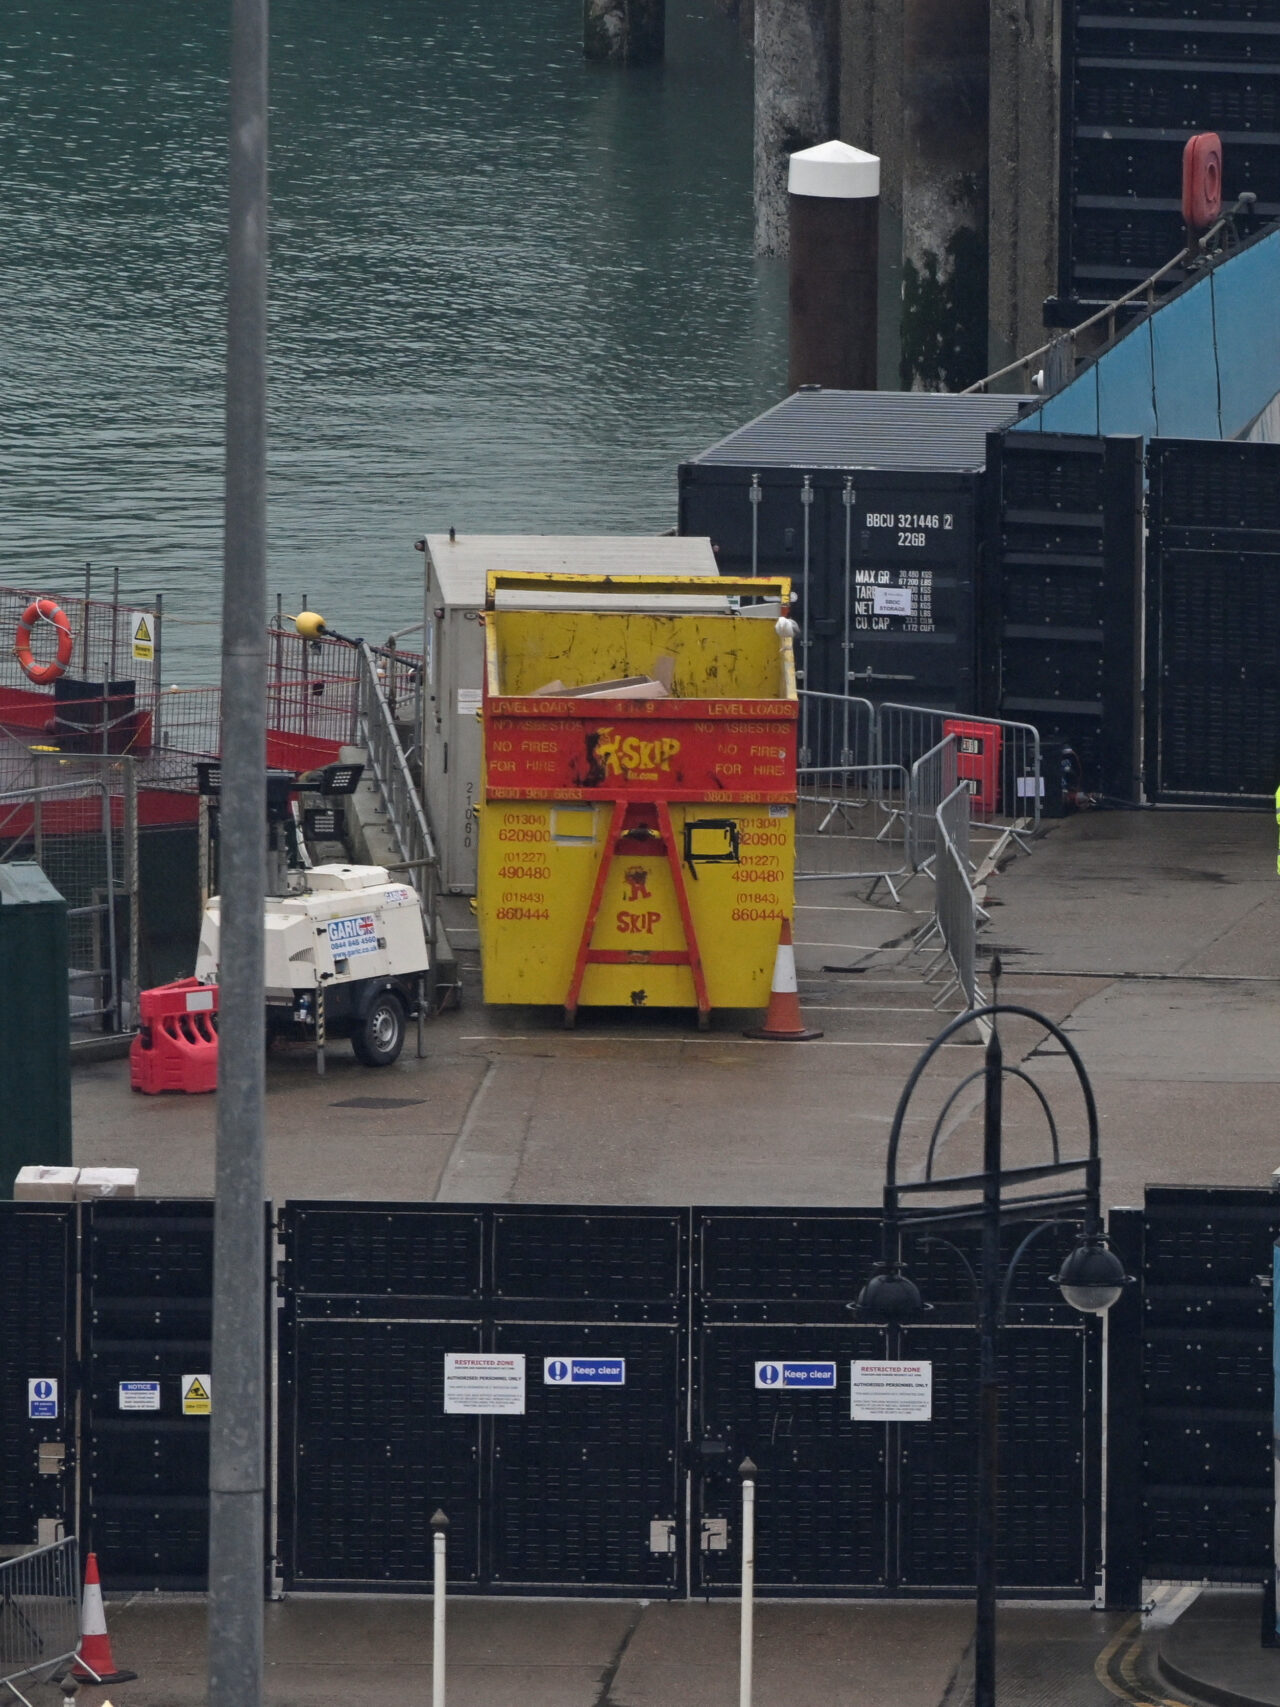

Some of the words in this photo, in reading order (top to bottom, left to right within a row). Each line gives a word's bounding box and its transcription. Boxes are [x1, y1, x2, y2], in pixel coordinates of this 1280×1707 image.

[866, 513, 895, 528] BBCU
[898, 514, 939, 529] 321446
[945, 515, 953, 529] 2
[855, 601, 873, 615] NET
[533, 702, 576, 713] LOADS
[708, 704, 746, 716] LEVEL
[750, 704, 792, 716] LOADS
[695, 722, 714, 733] NO
[493, 741, 512, 752] NO
[521, 741, 558, 753] FIRES
[718, 743, 738, 755] NO
[490, 760, 516, 772] FOR
[526, 760, 556, 772] HIRE
[715, 763, 742, 775] FOR
[753, 764, 784, 776] HIRE
[503, 813, 547, 826] (01304)
[498, 829, 551, 842] 620900
[504, 852, 547, 863] (01227)
[498, 866, 551, 879] 490480
[732, 869, 784, 882] 490480
[502, 892, 545, 903] (01843)
[737, 893, 779, 904] (01843)
[496, 907, 549, 920] 860444
[732, 908, 785, 921] 860444
[616, 911, 661, 934] SKIP
[329, 918, 367, 941] GARIC
[573, 1365, 596, 1376] Keep
[598, 1366, 621, 1375] clear
[784, 1369, 808, 1381] Keep
[809, 1370, 832, 1379] clear
